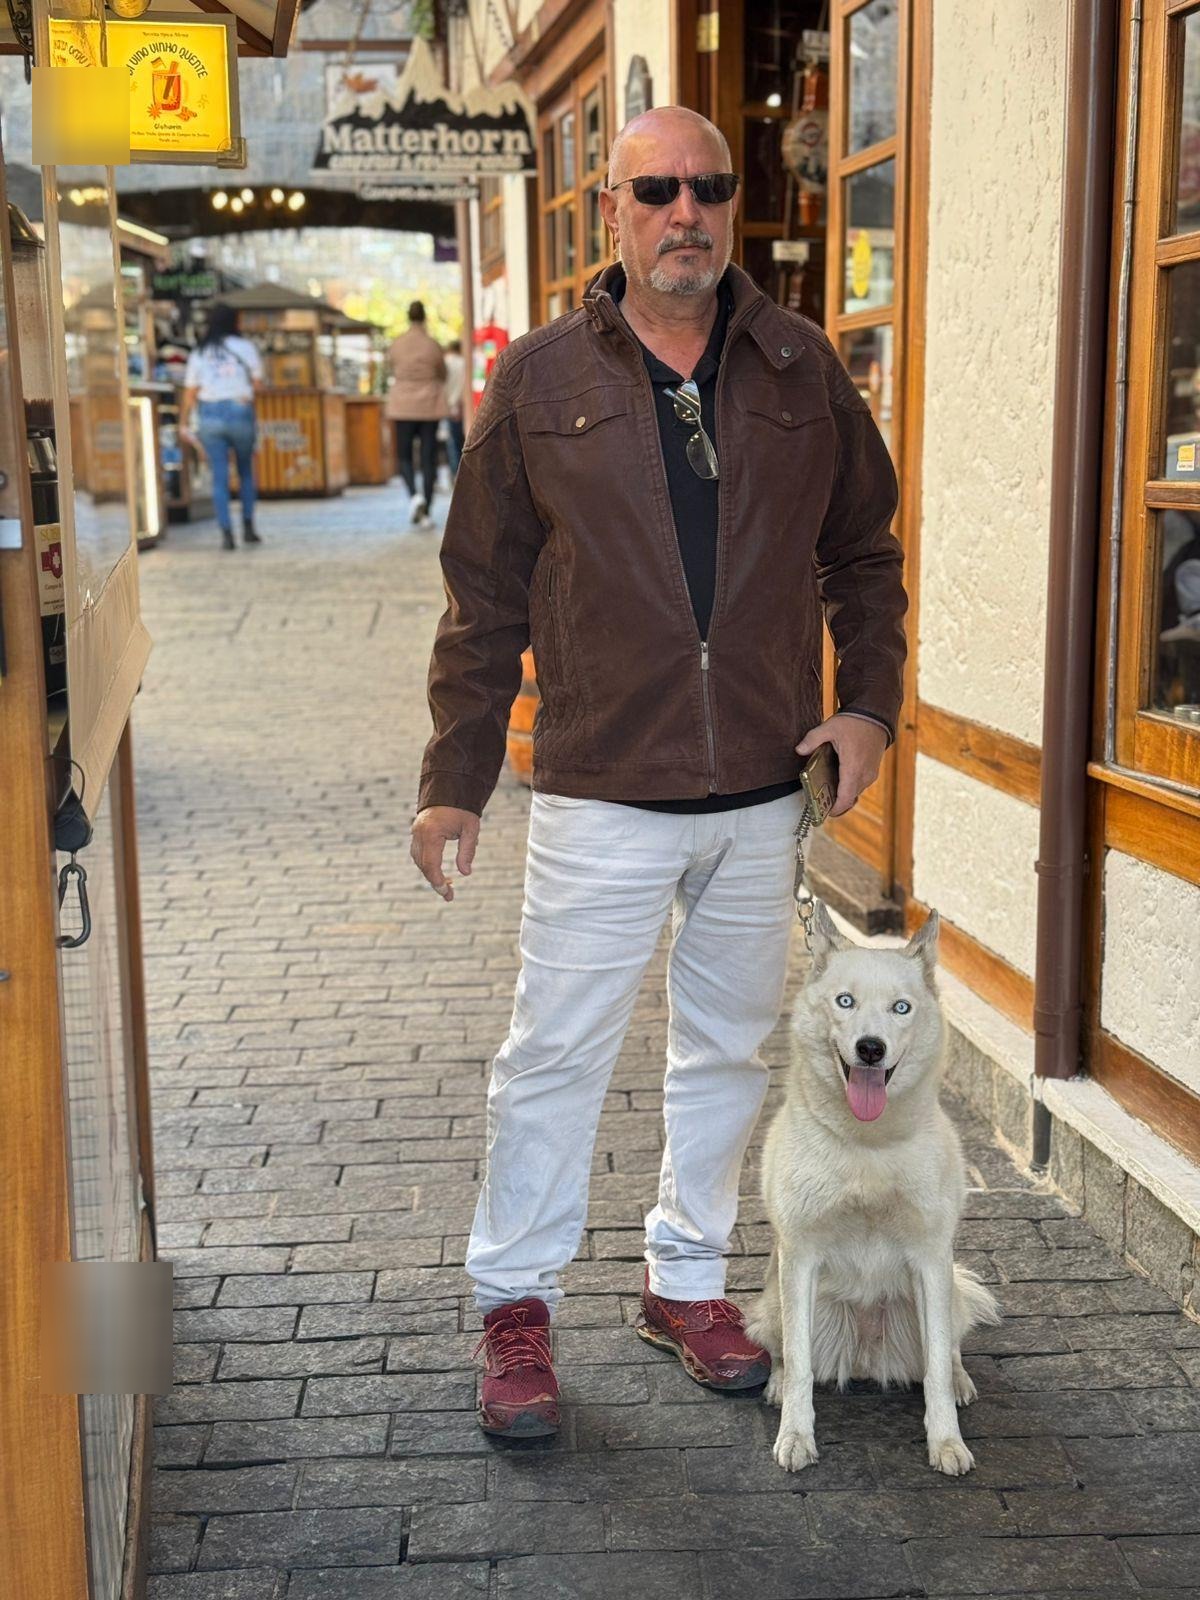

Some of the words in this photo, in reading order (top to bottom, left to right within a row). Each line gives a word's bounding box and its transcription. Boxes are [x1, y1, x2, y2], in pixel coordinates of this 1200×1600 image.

[129, 47, 149, 65] VINO
[149, 42, 178, 53] VINHO
[179, 47, 208, 78] QUENTE
[322, 122, 532, 154] Matterhorn
